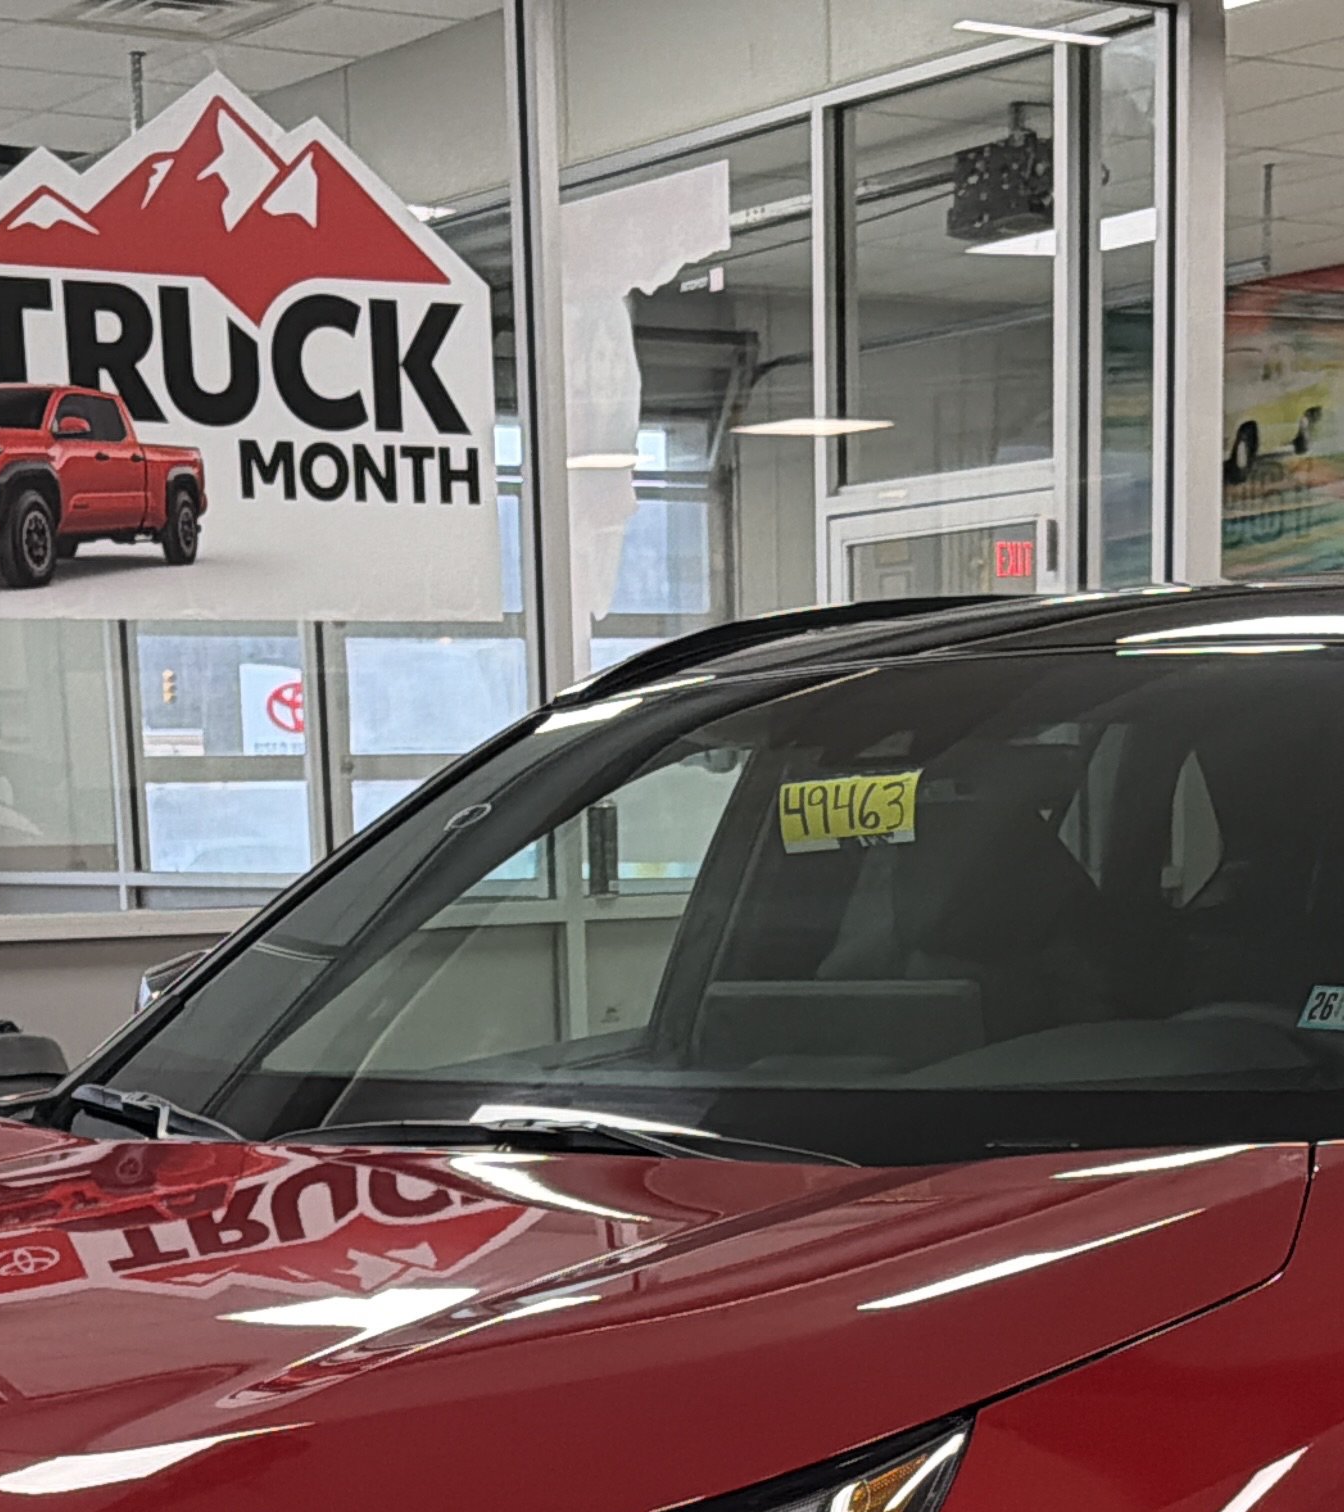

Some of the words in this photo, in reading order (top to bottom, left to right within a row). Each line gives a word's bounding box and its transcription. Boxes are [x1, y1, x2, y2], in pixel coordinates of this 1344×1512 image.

[239, 438, 481, 506] MONTH
[996, 541, 1033, 577] EXIT
[783, 777, 912, 836] 49463
[1307, 991, 1339, 1021] 26
